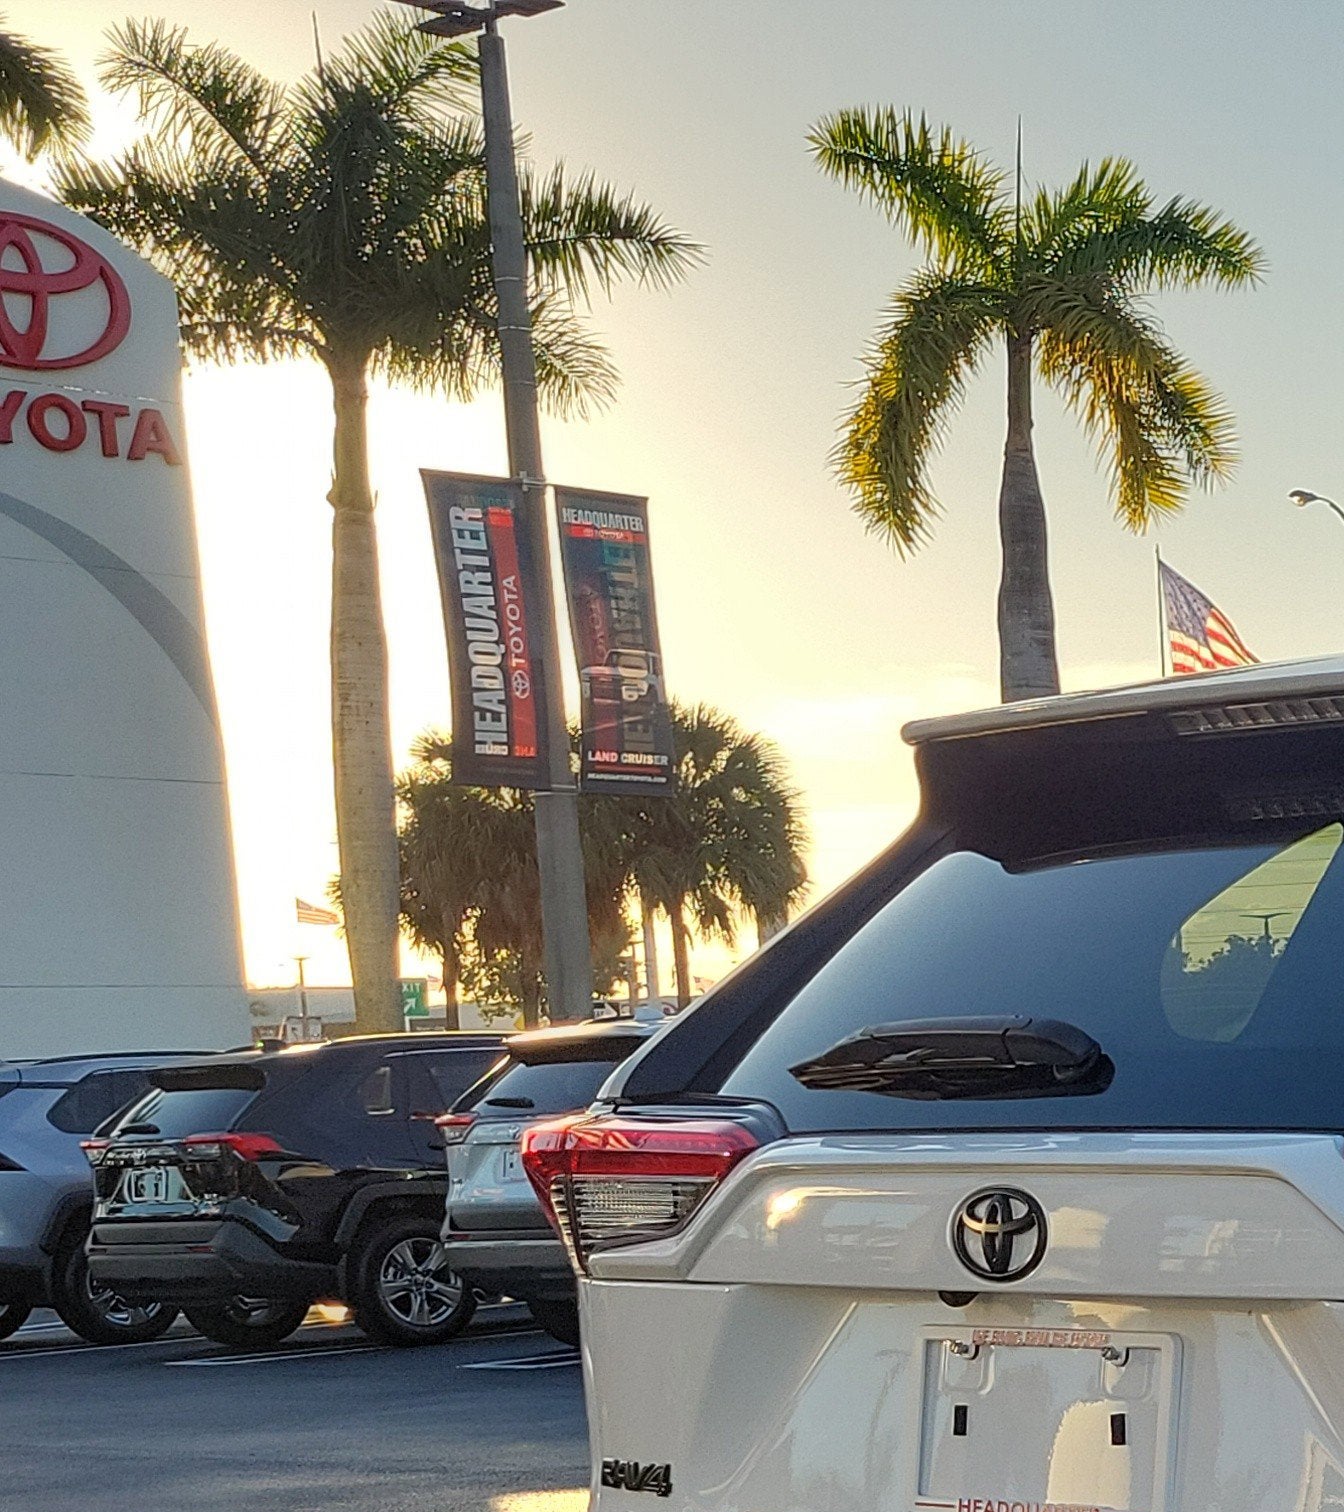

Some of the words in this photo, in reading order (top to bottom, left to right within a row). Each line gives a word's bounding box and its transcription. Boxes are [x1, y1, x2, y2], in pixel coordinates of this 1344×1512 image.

[562, 507, 644, 532] HEADQUARTER
[450, 505, 508, 756] HEADQUARTER
[503, 575, 525, 667] TOYOTA
[588, 750, 618, 763] LAND
[621, 752, 669, 766] CRUISER
[601, 1459, 672, 1497] RAV4
